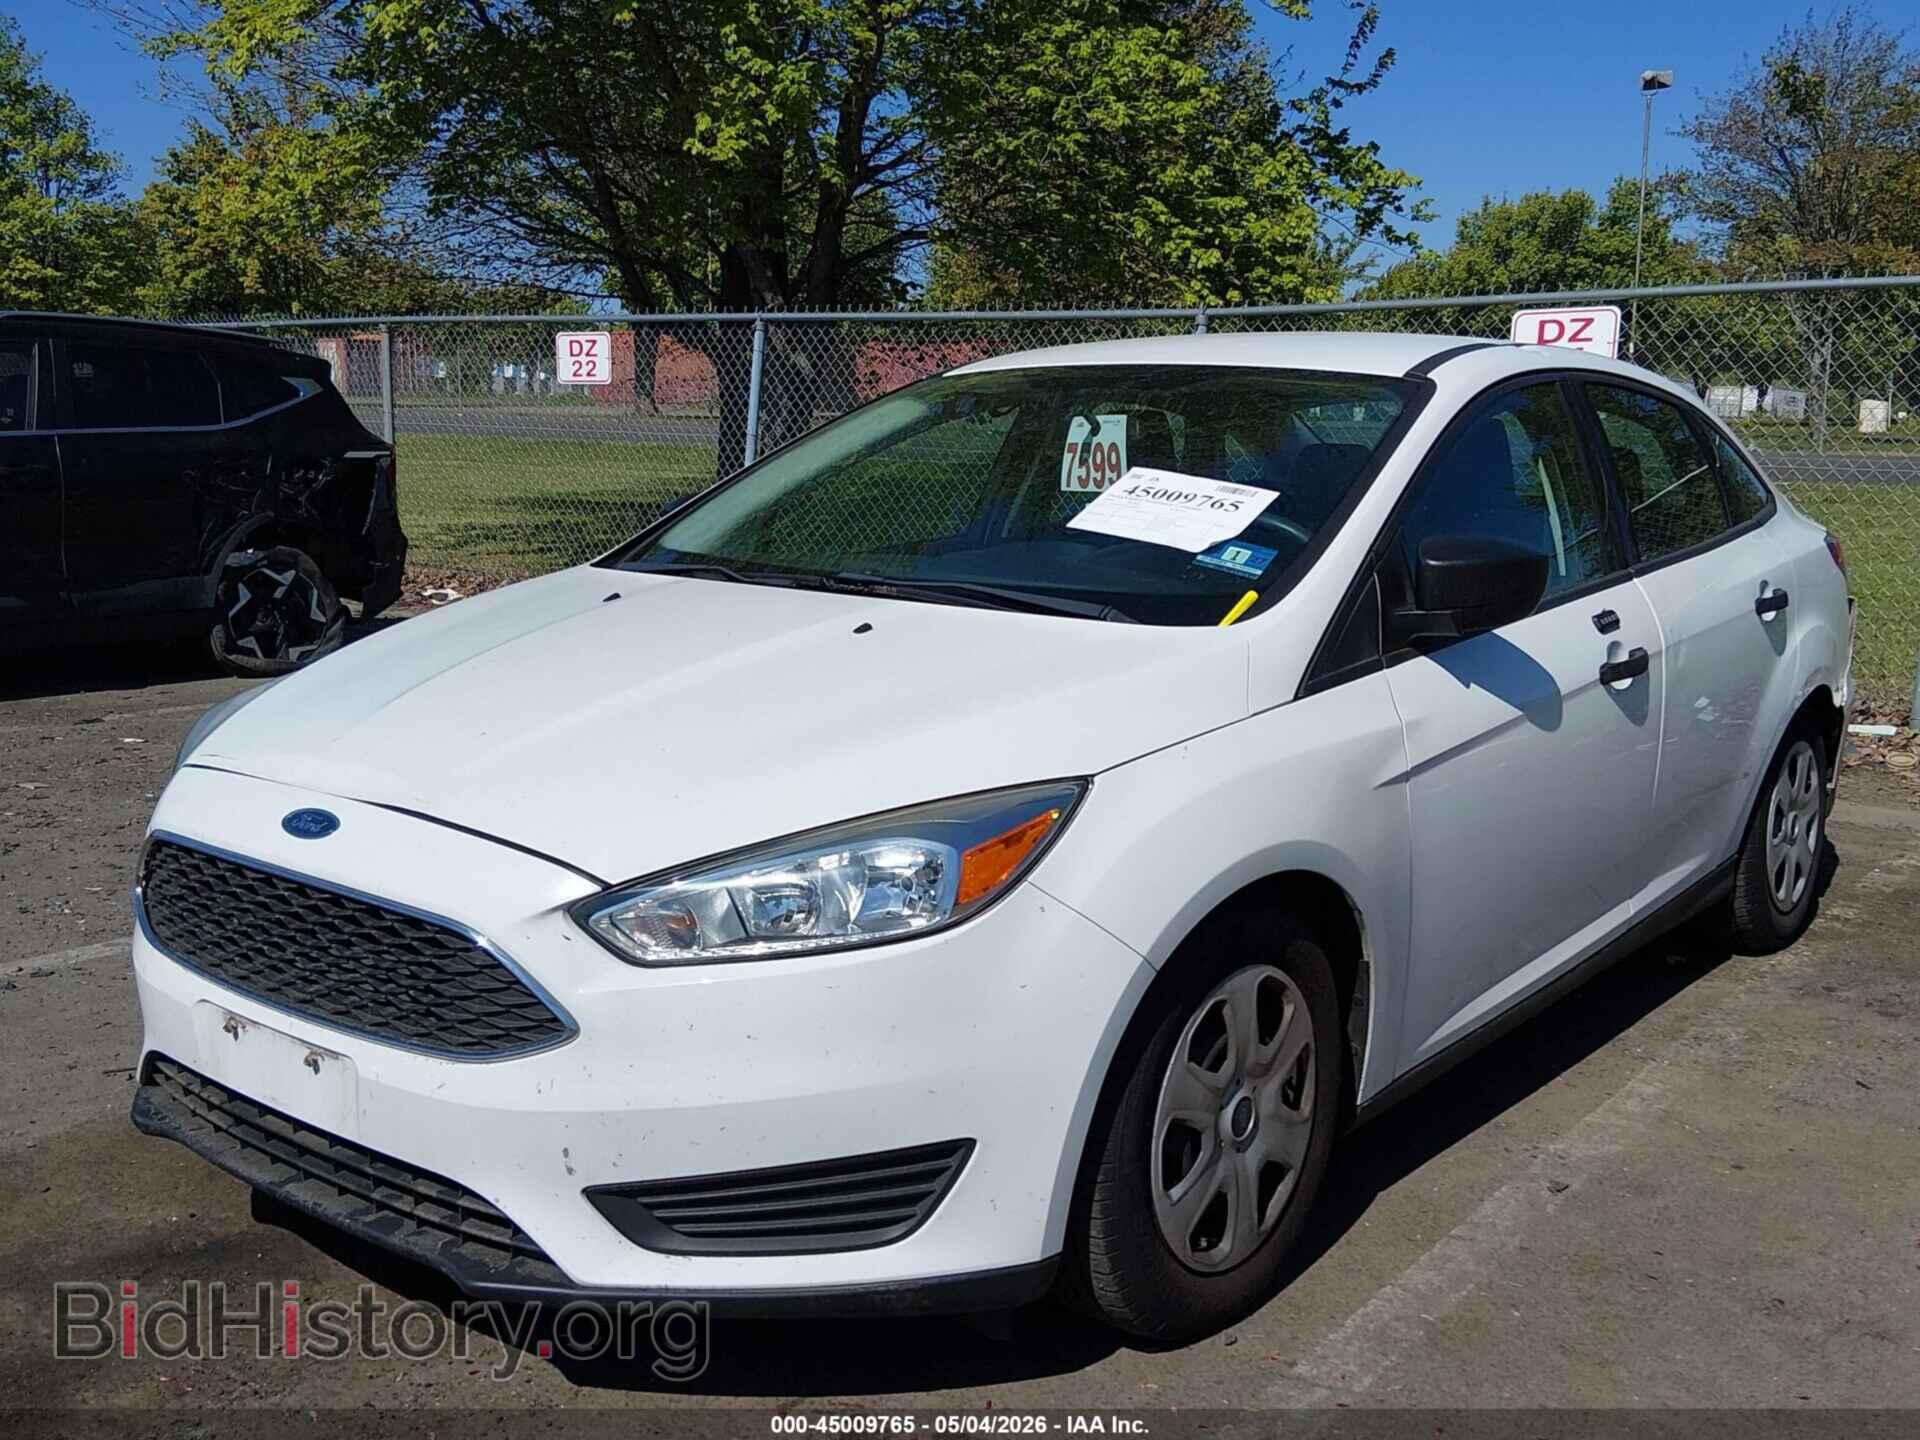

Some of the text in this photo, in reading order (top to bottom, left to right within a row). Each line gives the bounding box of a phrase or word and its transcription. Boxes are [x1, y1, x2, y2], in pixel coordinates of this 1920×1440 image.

[1537, 317, 1595, 345] DZ
[568, 339, 598, 357] DZ
[572, 360, 597, 377] 22
[1066, 441, 1122, 490] 7599
[1123, 484, 1245, 513] 45009765
